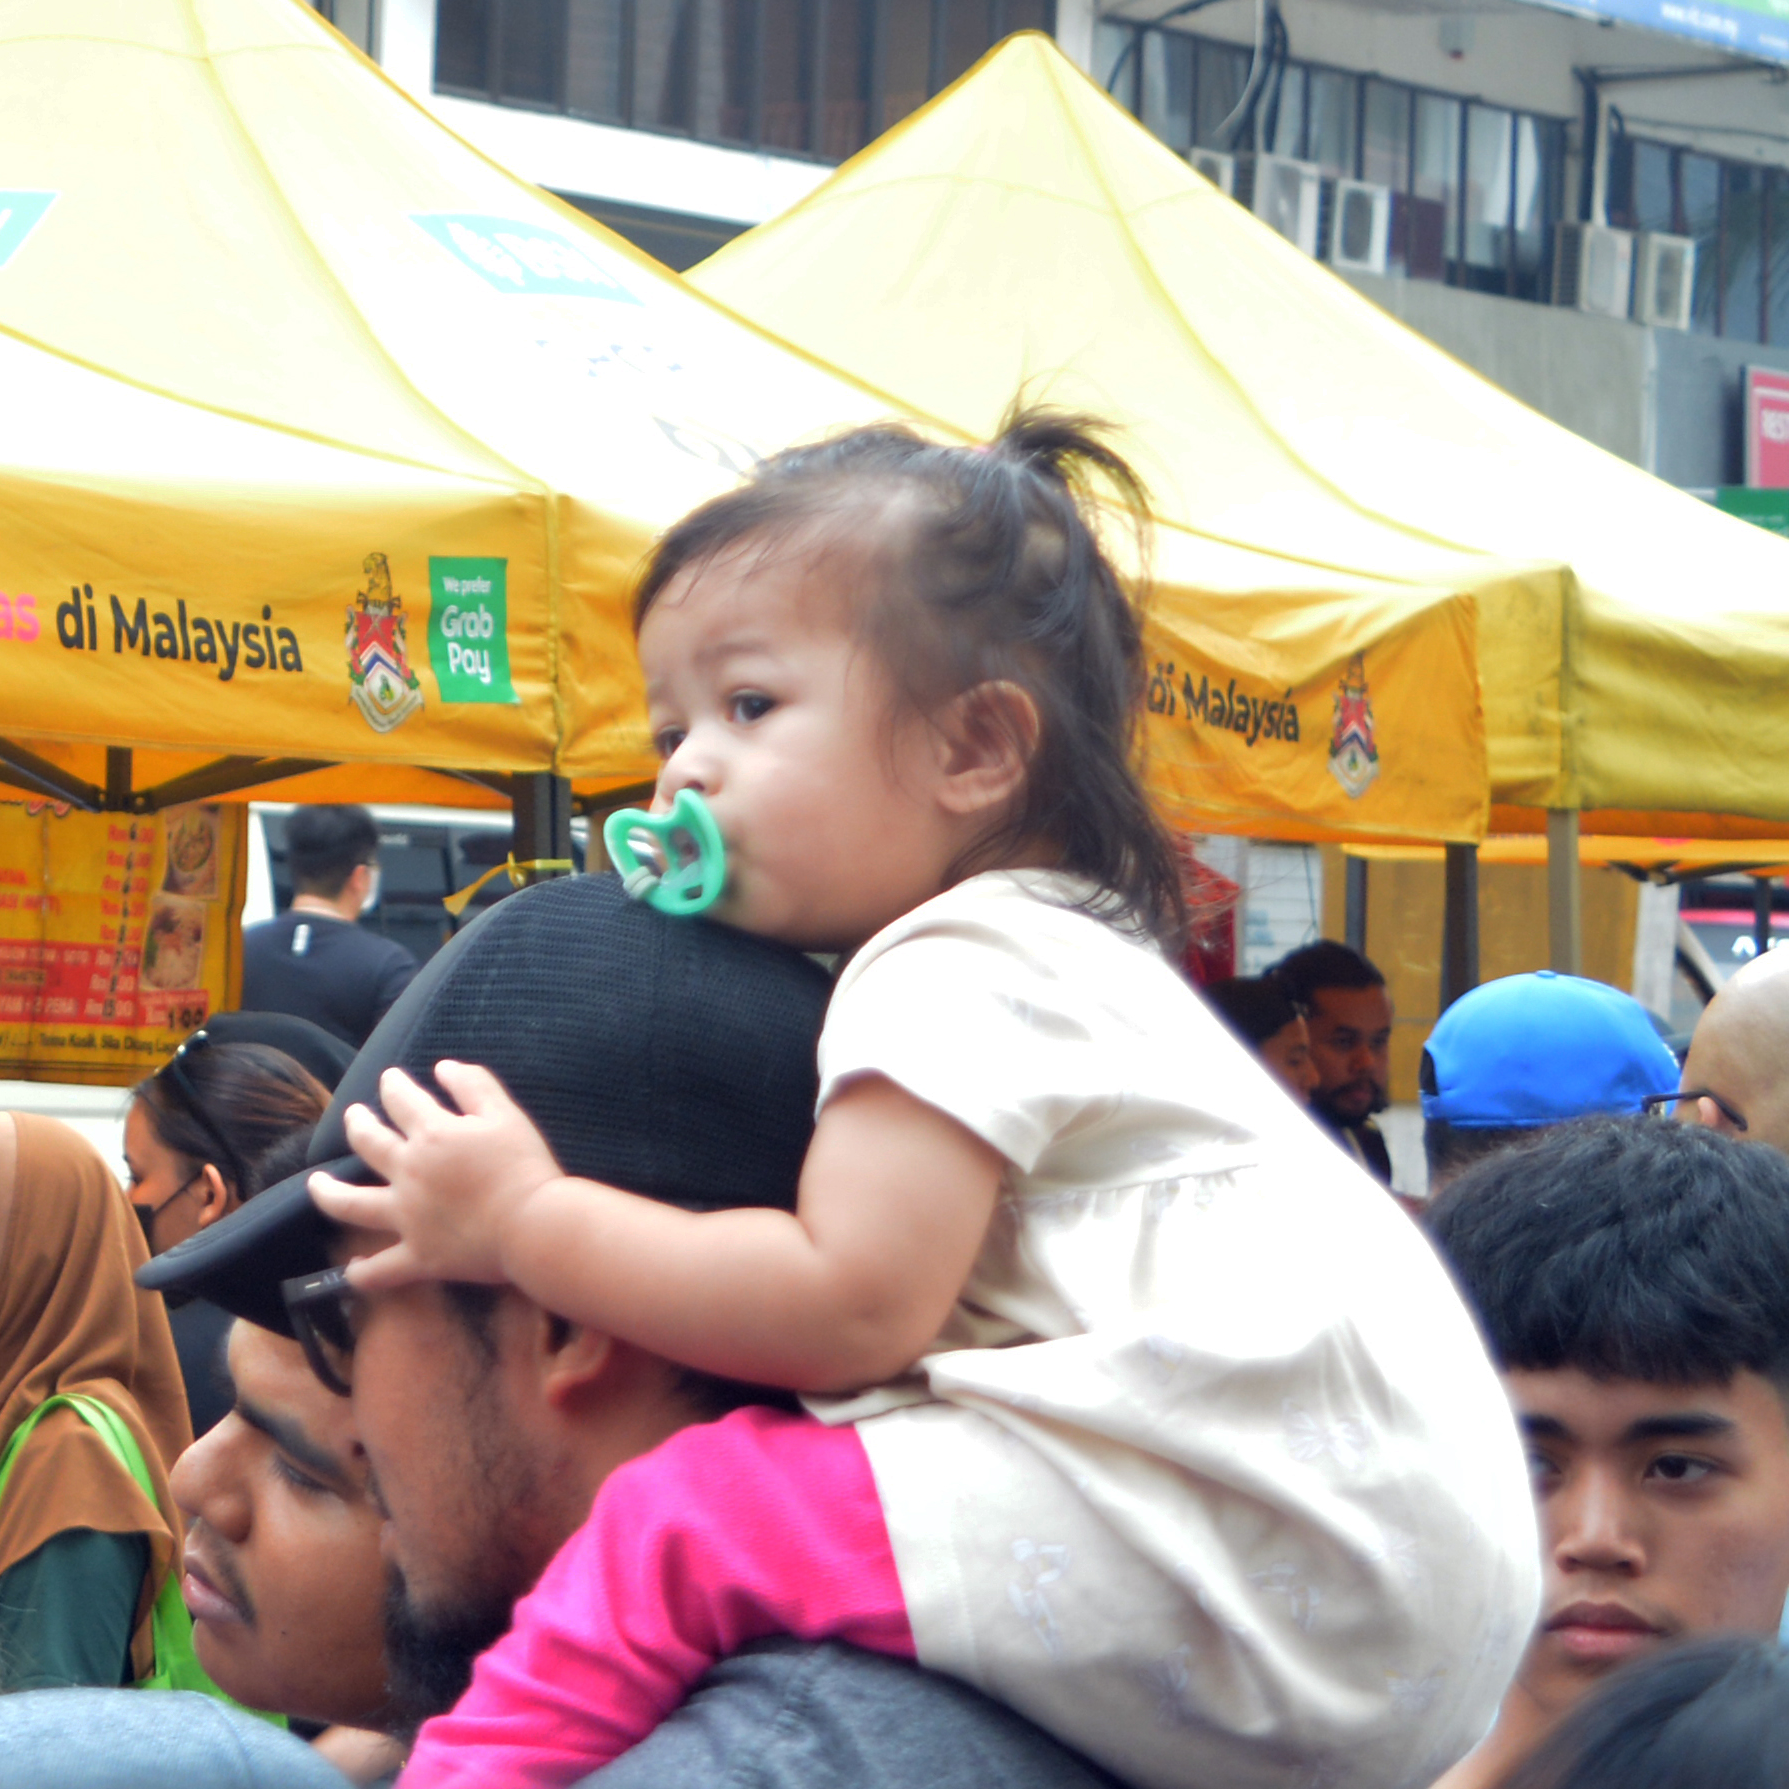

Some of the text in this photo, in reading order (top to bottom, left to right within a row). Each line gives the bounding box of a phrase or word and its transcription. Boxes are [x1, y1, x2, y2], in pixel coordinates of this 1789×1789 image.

[442, 575, 492, 597] We prefer
[56, 584, 97, 651] di
[109, 593, 303, 681] Malaysia
[440, 603, 494, 638] Grab
[447, 641, 492, 684] Pay
[1182, 672, 1300, 747] Malaysia
